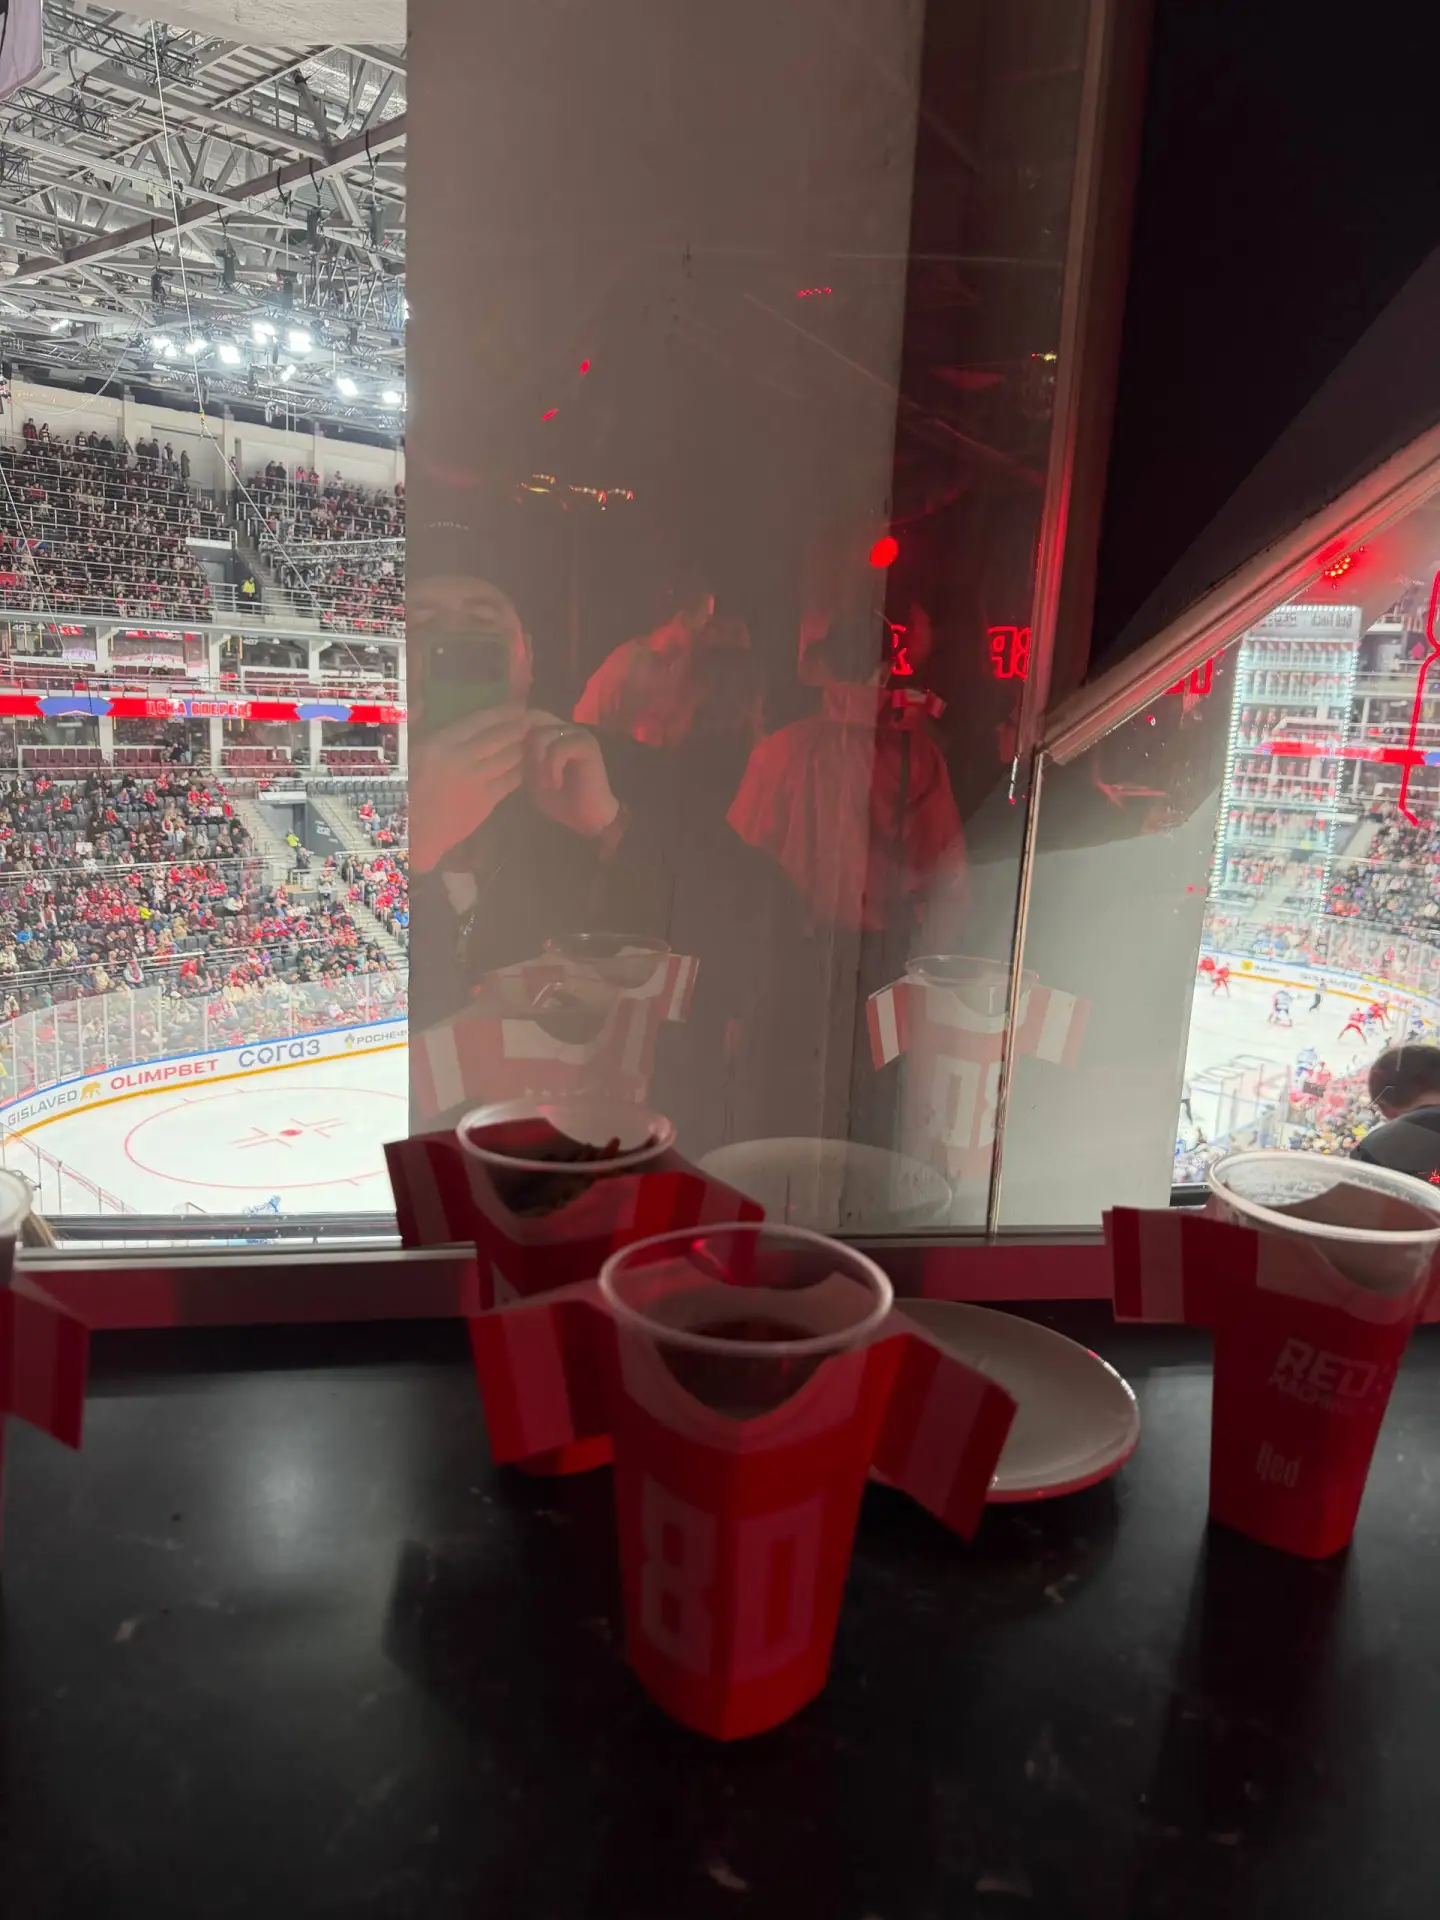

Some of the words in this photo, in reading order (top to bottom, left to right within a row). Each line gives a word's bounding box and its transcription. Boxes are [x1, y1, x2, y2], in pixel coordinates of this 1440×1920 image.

[110, 1059, 219, 1090] OLIMPBET
[7, 1090, 78, 1127] GISLAVED
[1275, 1337, 1379, 1399] RED
[641, 1472, 826, 1684] 80
